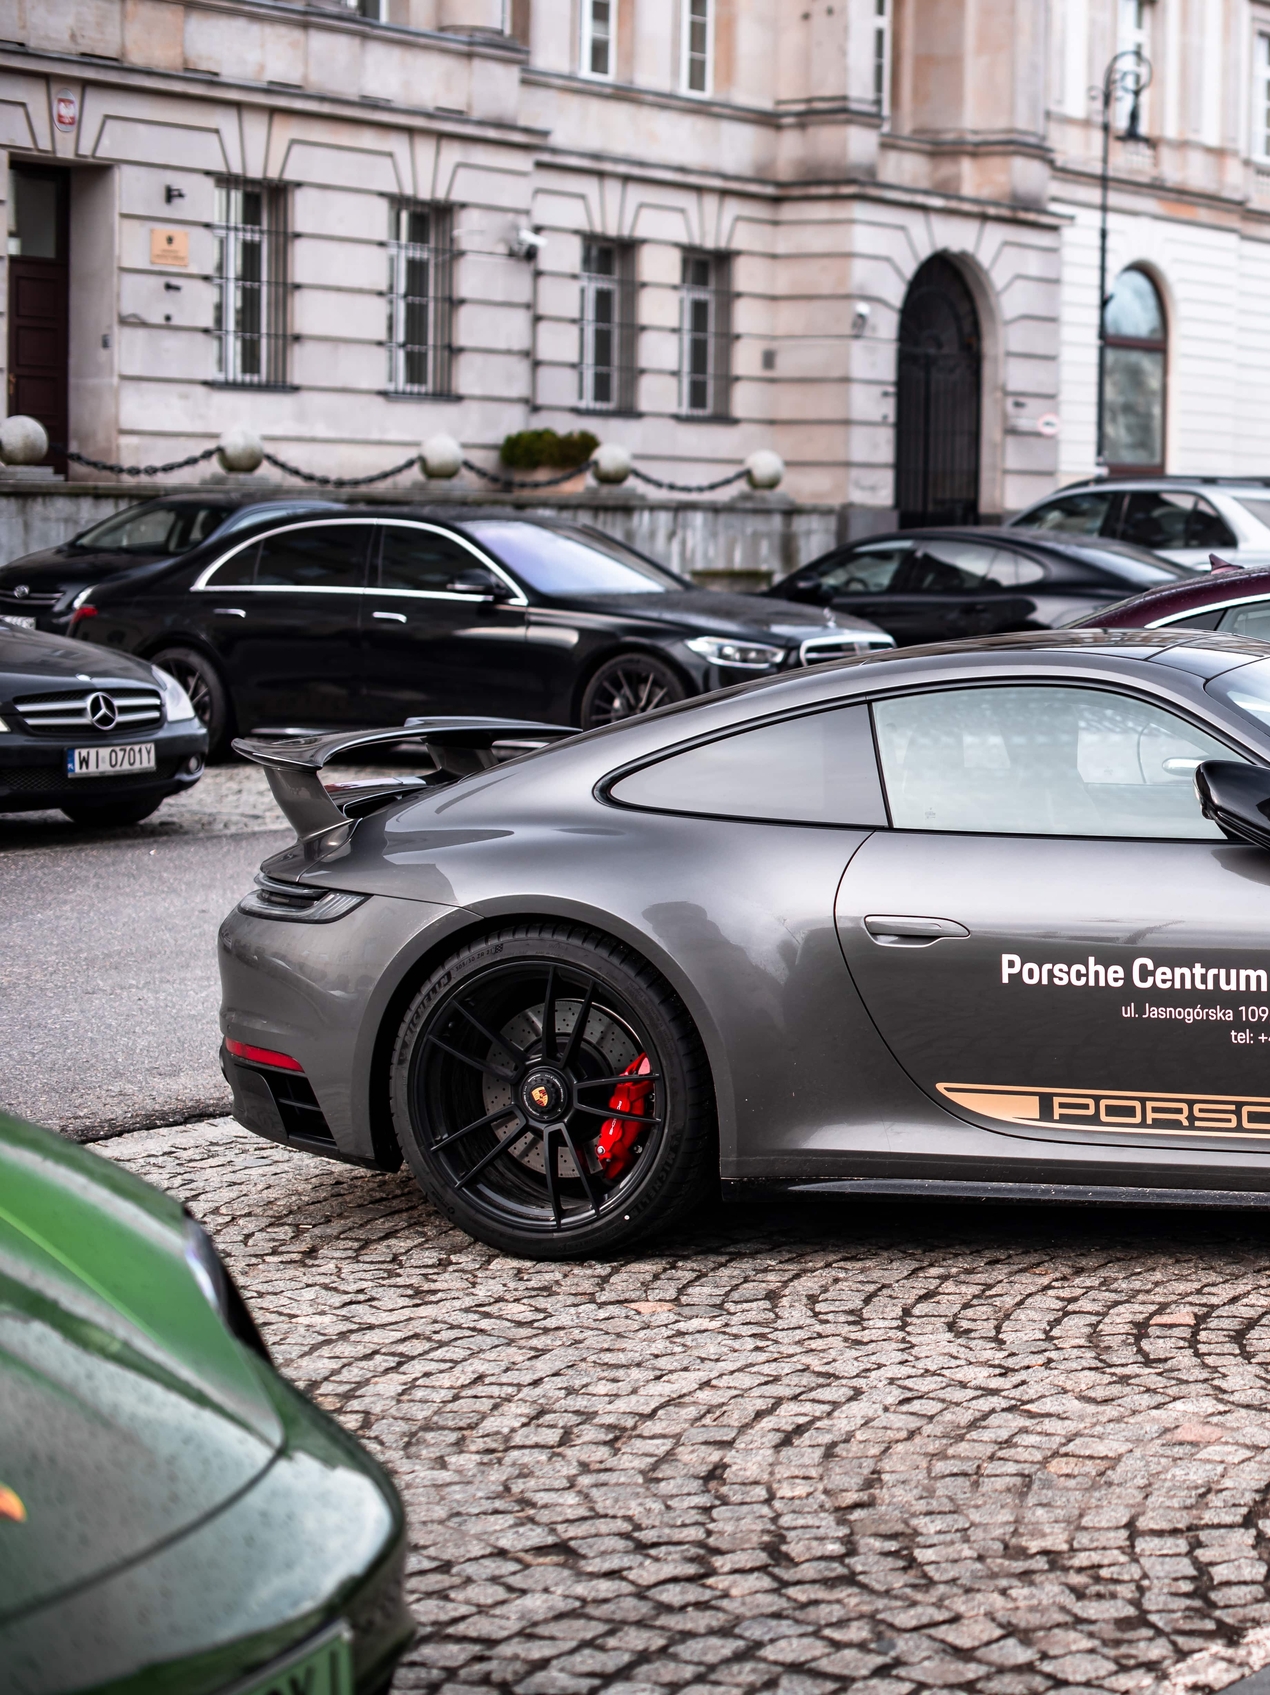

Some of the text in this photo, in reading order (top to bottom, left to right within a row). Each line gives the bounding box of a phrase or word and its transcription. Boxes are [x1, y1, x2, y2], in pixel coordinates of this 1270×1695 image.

[78, 745, 152, 771] WI 0701Y
[1001, 953, 1125, 988] Porsche
[1132, 957, 1268, 992] Centrum
[404, 973, 450, 1047] MICHELIN
[1122, 1002, 1139, 1018] ul.
[1142, 1002, 1234, 1024] Jasnogórska
[1230, 1029, 1254, 1044] tel:
